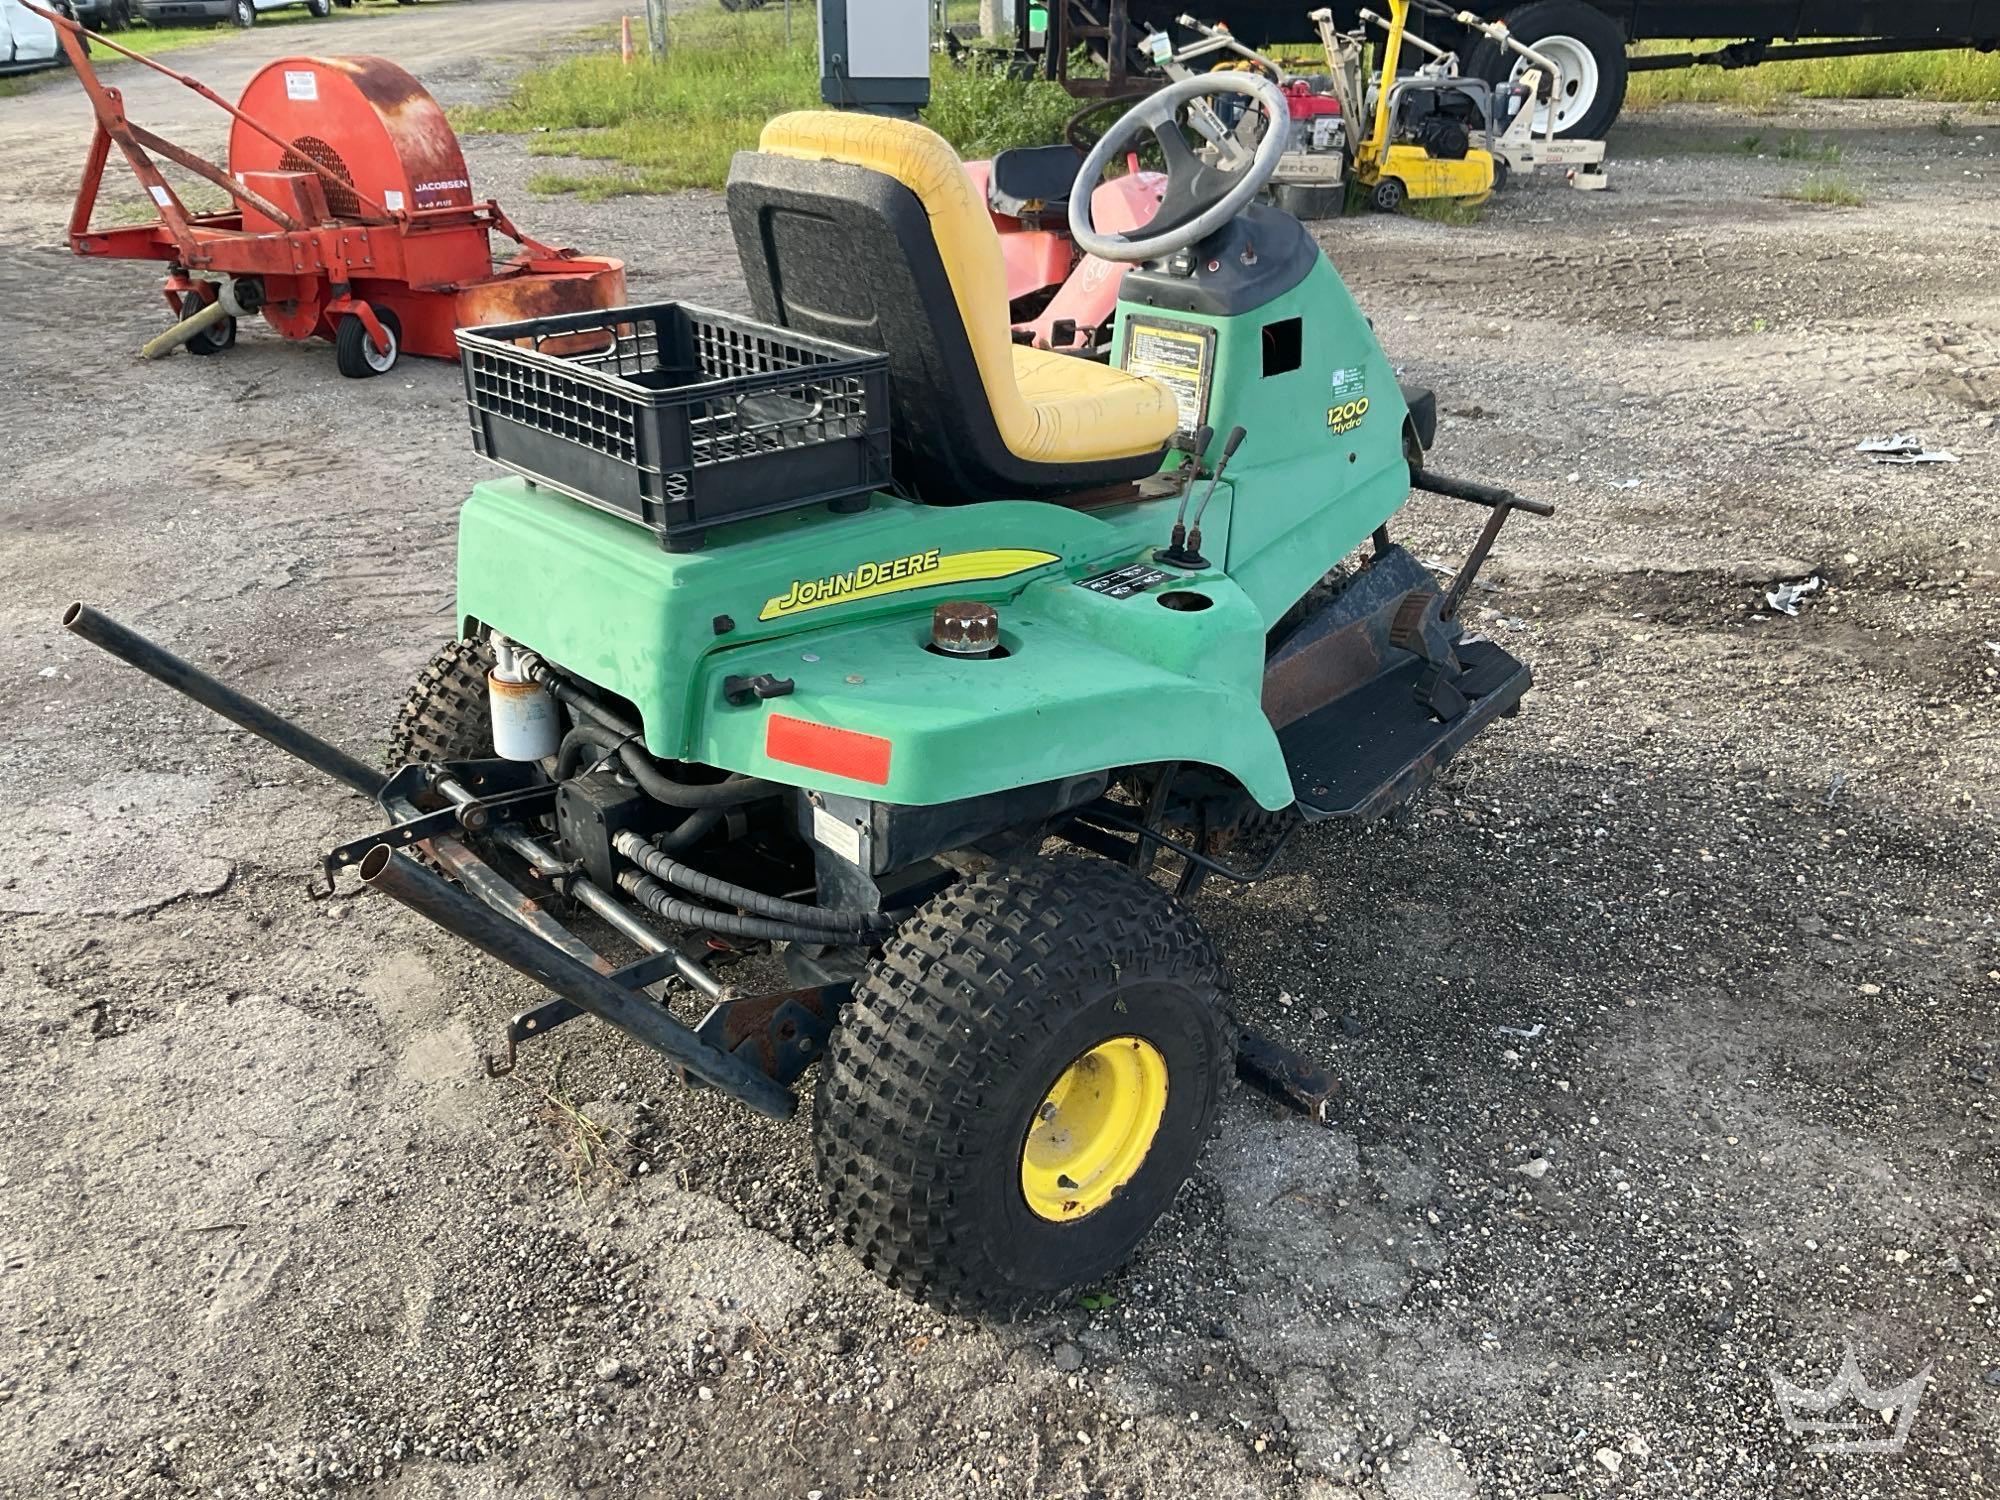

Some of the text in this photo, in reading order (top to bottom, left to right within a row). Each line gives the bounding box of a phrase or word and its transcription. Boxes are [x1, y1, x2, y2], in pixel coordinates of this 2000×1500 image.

[414, 180, 468, 193] JACOBSEN
[1327, 397, 1369, 426] 1200
[1333, 418, 1362, 435] Hydro
